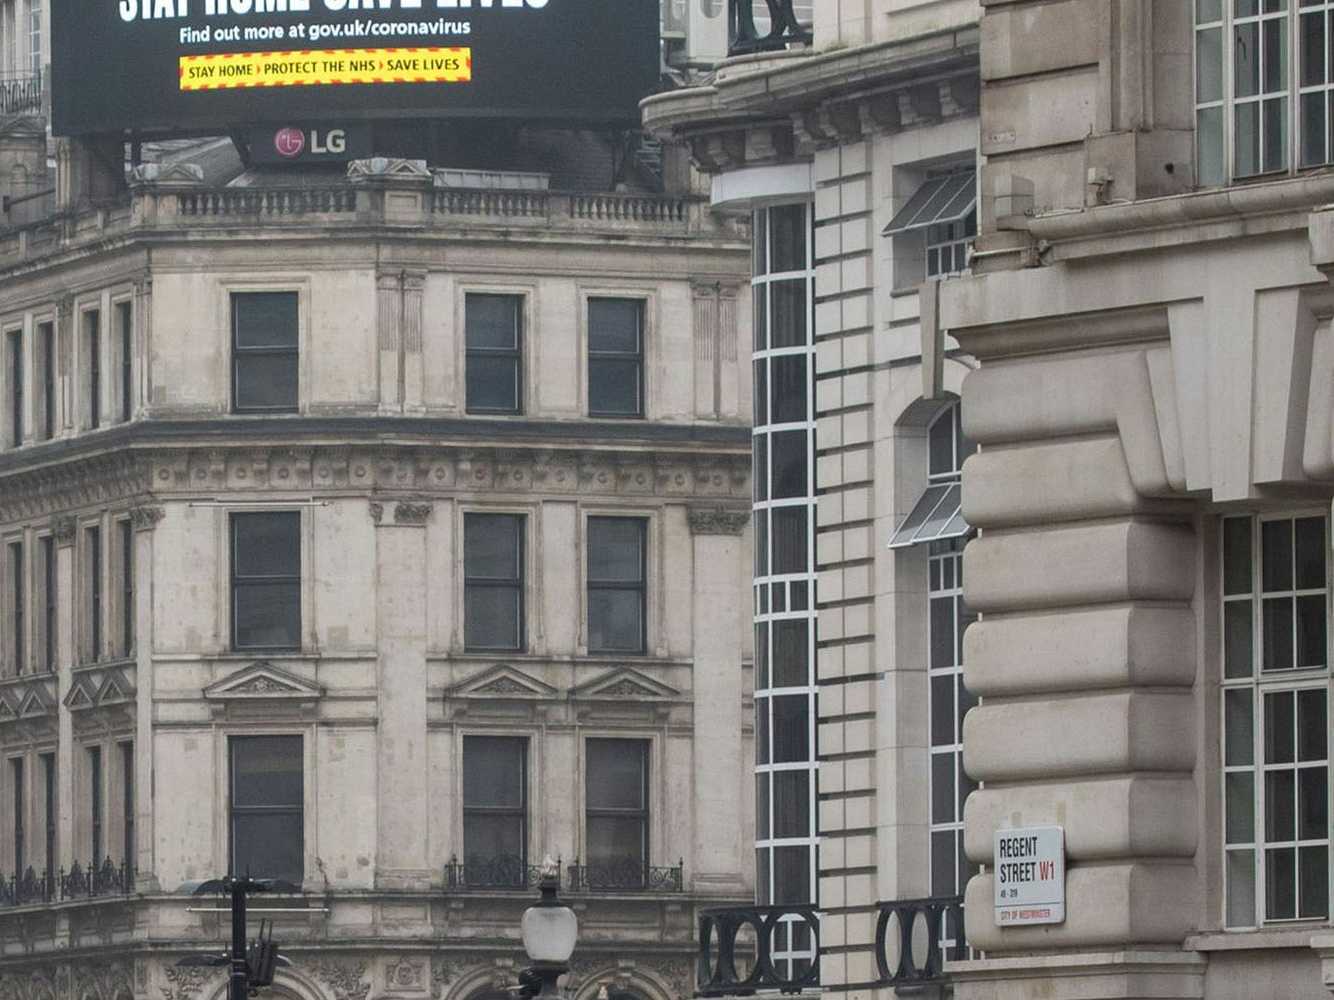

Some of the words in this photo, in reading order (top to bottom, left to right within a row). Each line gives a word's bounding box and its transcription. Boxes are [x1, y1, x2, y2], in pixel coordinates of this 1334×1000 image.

[179, 27, 209, 43] Find
[214, 27, 240, 41] out
[244, 26, 284, 39] more
[288, 23, 305, 37] at
[309, 19, 471, 41] gov.uk/coronavirus
[188, 65, 215, 79] STAY
[218, 64, 253, 77] HOME
[264, 61, 318, 75] PROTECT
[322, 60, 345, 73] THE
[349, 59, 376, 72] NHS
[387, 58, 419, 71] SAVE
[423, 57, 460, 71] LIVES
[310, 130, 346, 153] LG
[999, 836, 1038, 858] REGENT
[1000, 862, 1037, 883] STREET
[1039, 861, 1055, 880] W1
